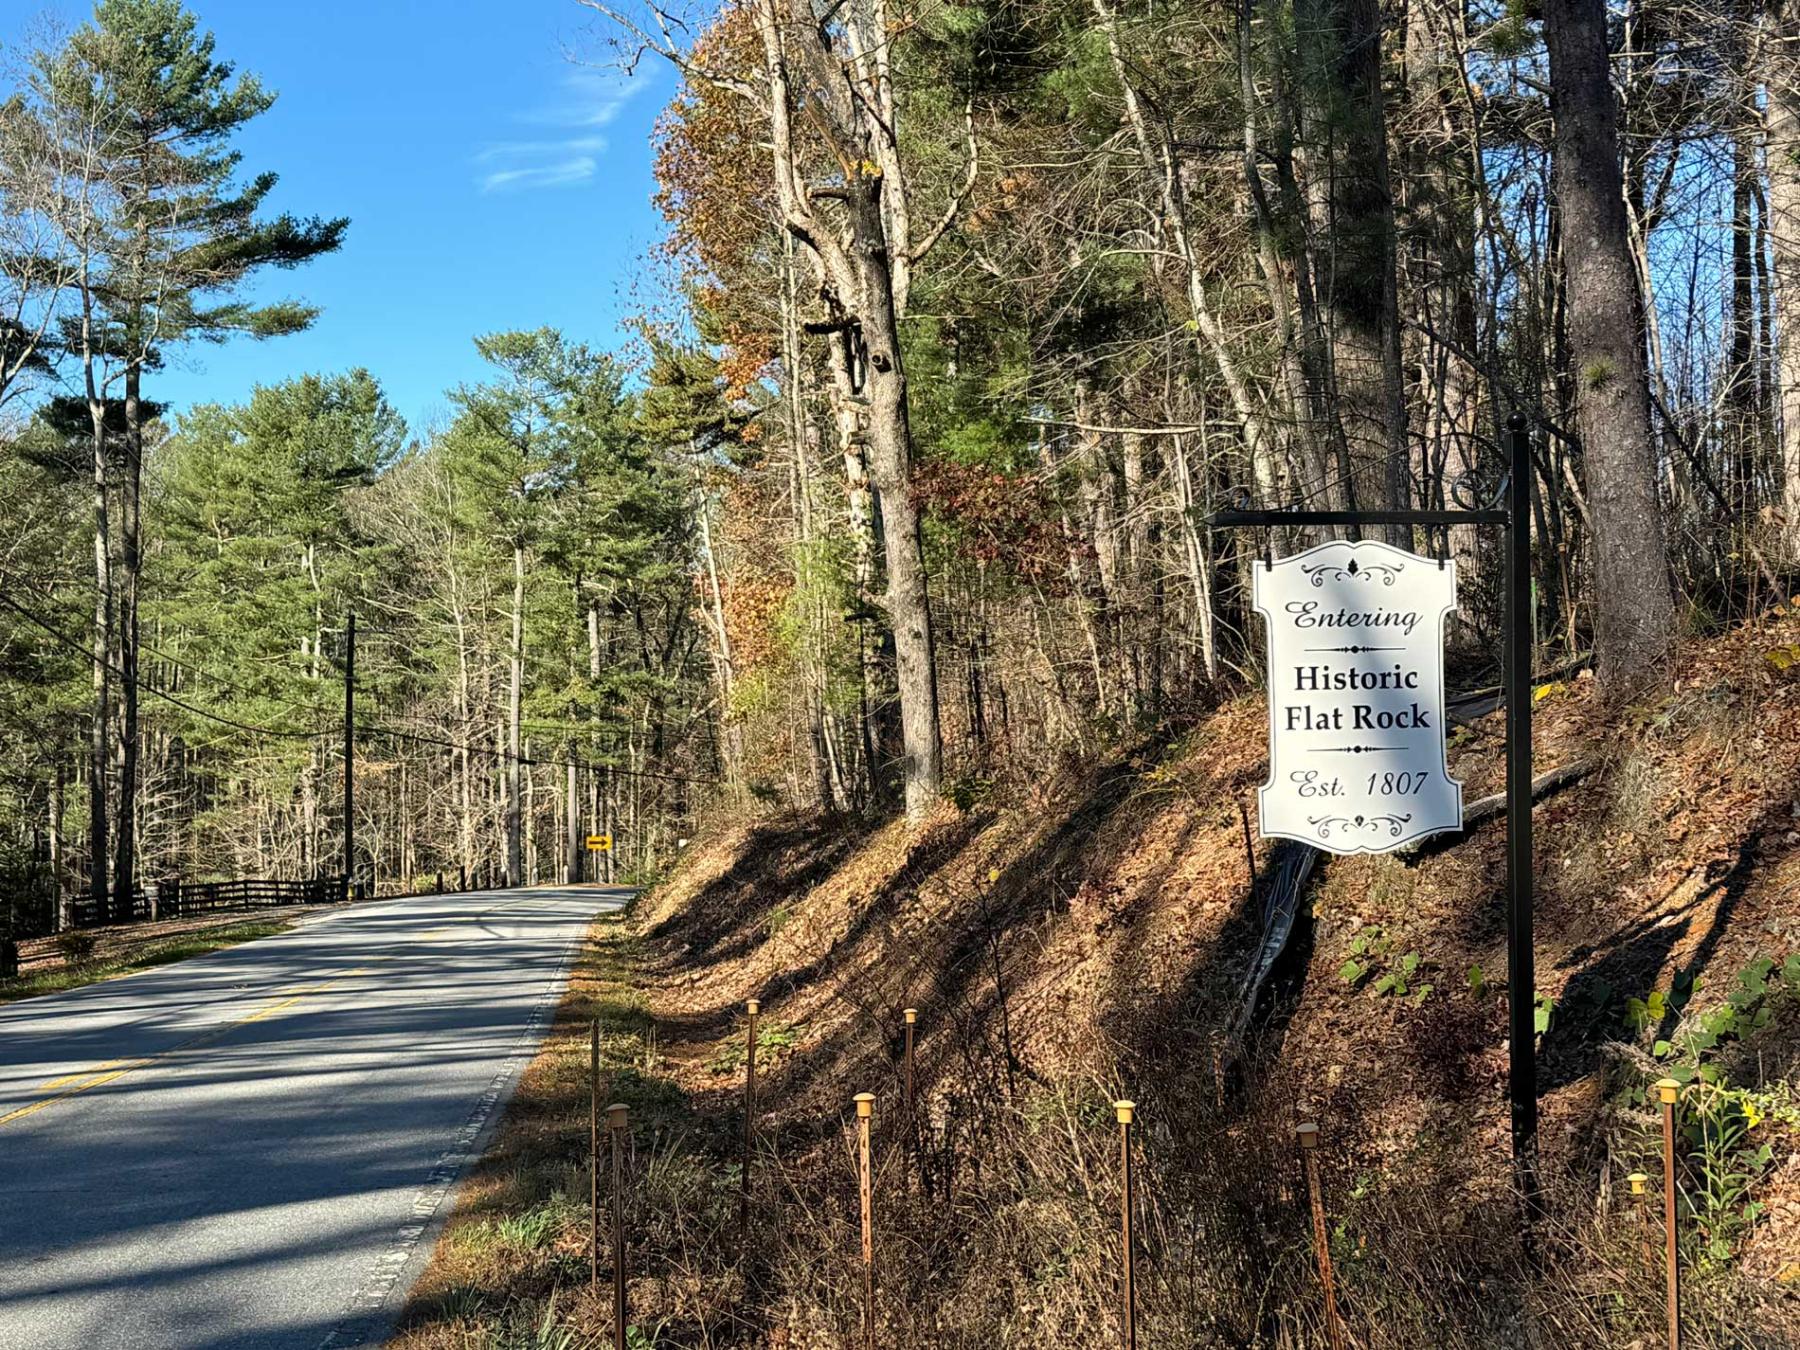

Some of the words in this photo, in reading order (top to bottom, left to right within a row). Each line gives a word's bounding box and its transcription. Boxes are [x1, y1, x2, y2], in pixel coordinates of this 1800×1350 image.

[1285, 601, 1423, 636] Entering
[1294, 664, 1418, 691] Historic
[1285, 705, 1343, 731] Flat
[1352, 703, 1431, 730] Rock
[1290, 770, 1345, 797] Est.
[1367, 771, 1429, 796] 1807
